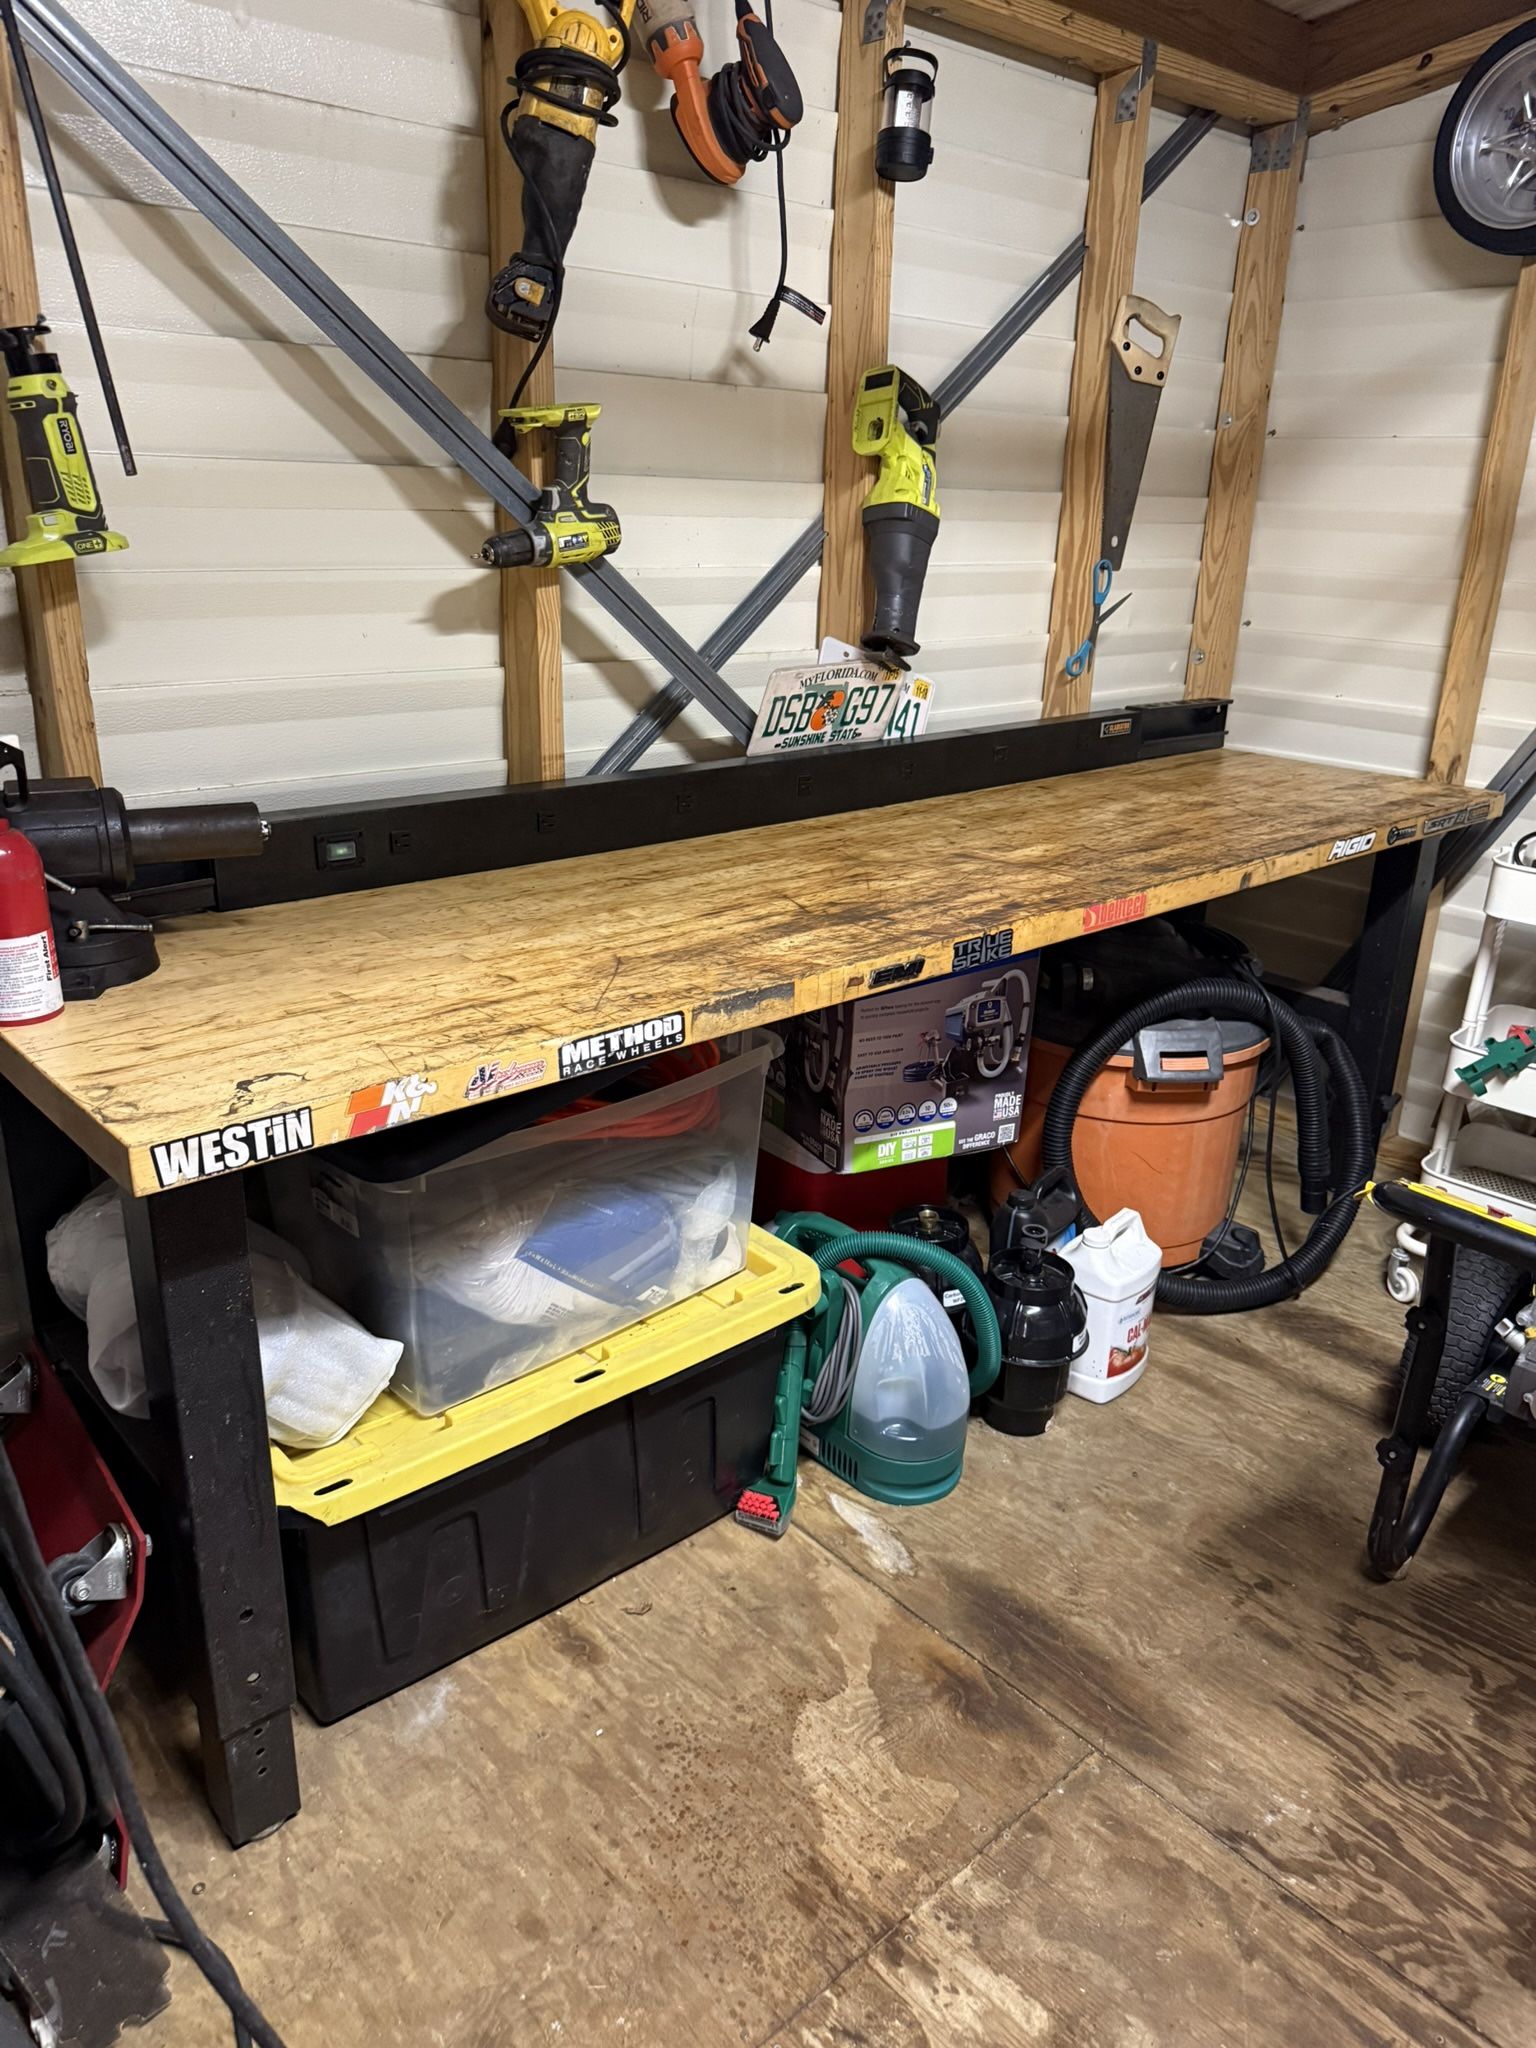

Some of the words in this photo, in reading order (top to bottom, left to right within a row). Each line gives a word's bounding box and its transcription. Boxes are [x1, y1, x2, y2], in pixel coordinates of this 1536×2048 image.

[58, 419, 75, 453] RYOBI
[761, 691, 818, 738] DSB
[840, 683, 896, 727] G97
[1328, 832, 1377, 862] RIGID
[41, 935, 50, 958] Alert
[561, 1014, 683, 1066] METHOD
[563, 1057, 607, 1076] RACE
[615, 1033, 684, 1061] WHEELS
[993, 1095, 1022, 1108] MADE
[1002, 1106, 1020, 1118] USA
[974, 1131, 996, 1142] GRACO
[877, 1142, 897, 1158] DIY
